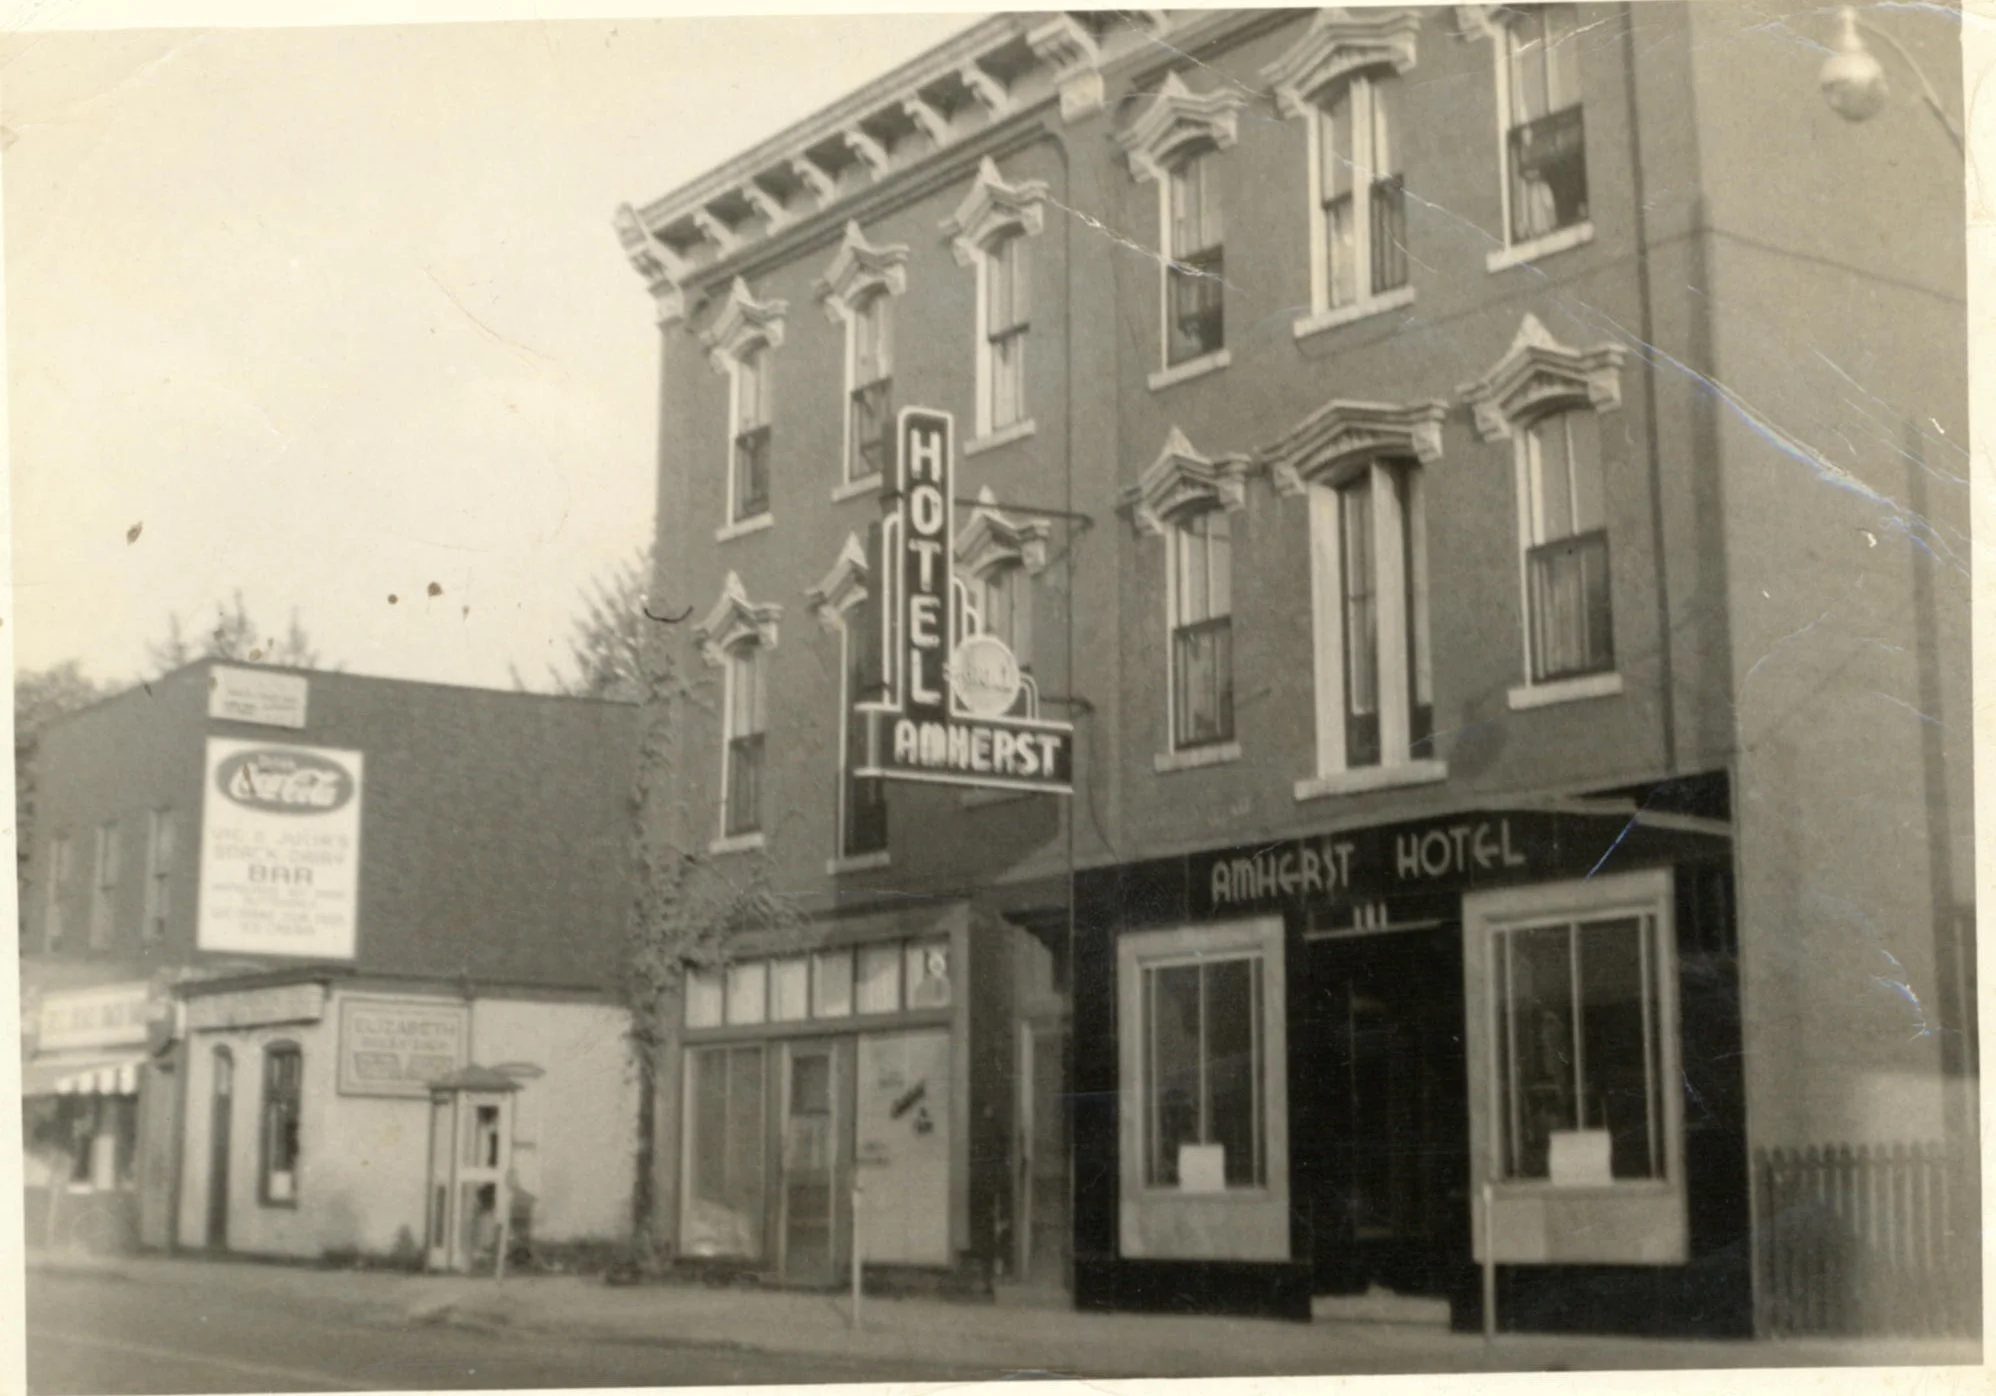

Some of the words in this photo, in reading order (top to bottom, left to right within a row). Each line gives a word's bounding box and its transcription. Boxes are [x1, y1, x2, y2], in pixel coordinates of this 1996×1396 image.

[908, 428, 943, 705] HOTEL
[894, 718, 1062, 778] AMHERST
[248, 864, 314, 887] BAR
[1212, 843, 1354, 905] AMHERST
[1398, 819, 1526, 879] HOTEL
